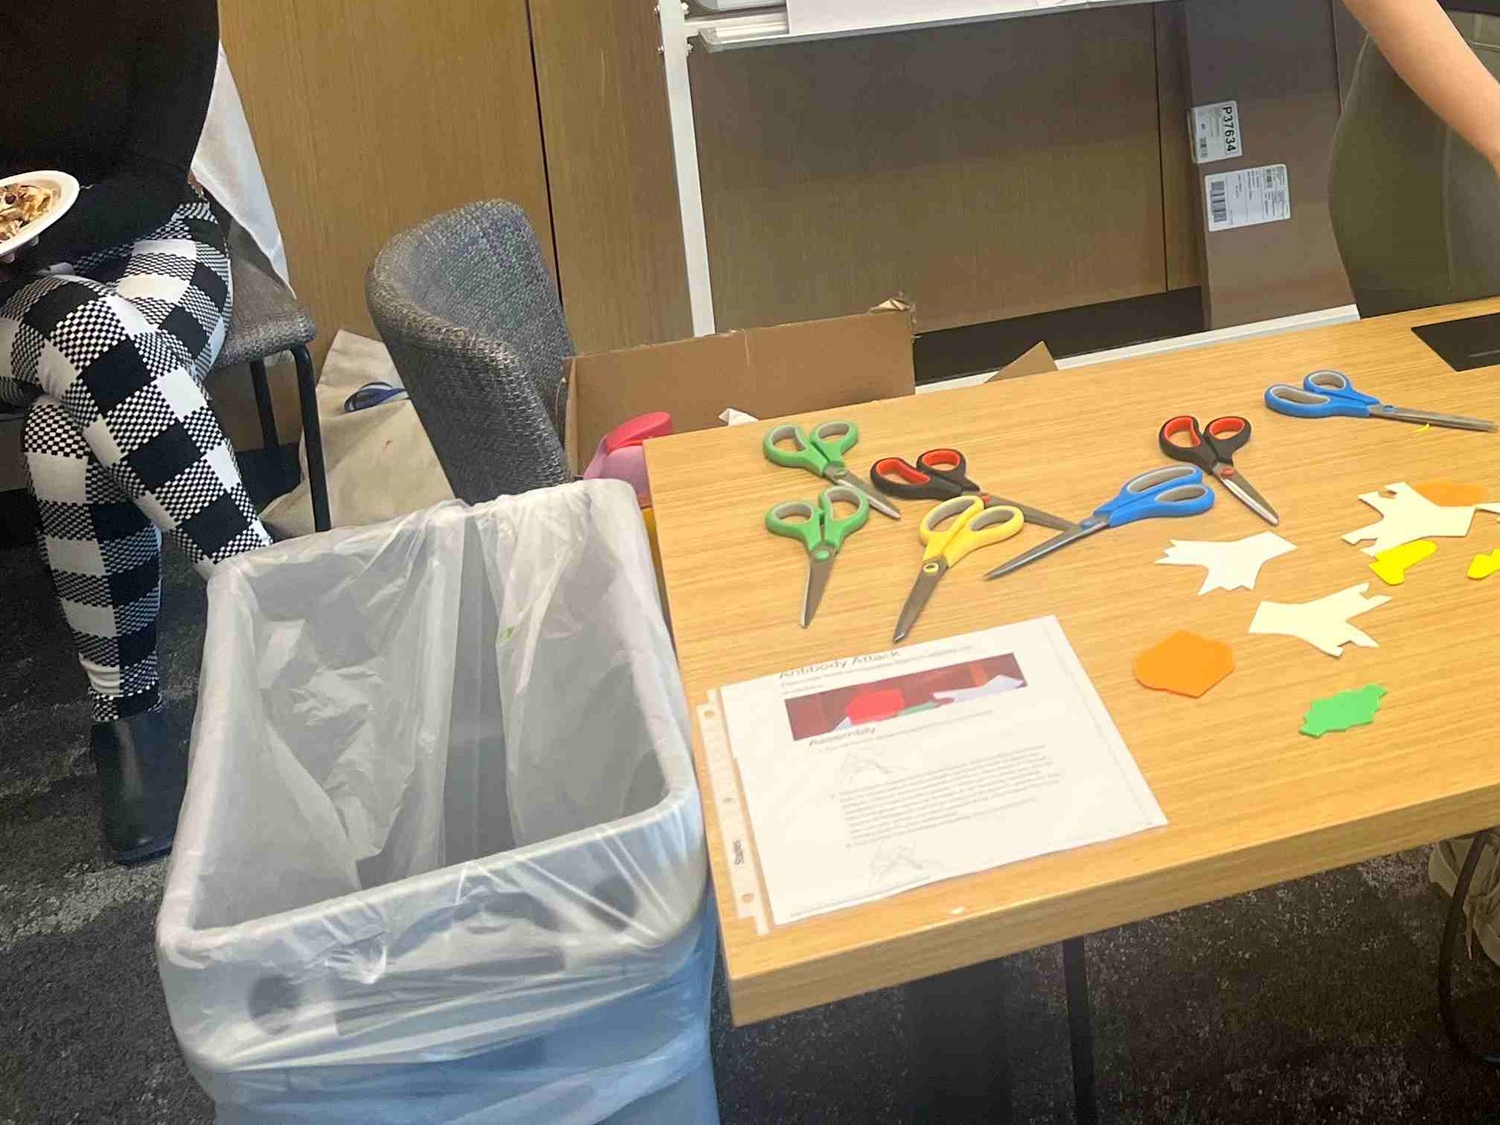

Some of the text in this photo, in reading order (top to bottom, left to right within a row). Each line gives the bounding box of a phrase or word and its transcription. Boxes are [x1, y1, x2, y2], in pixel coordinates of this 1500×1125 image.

[1221, 106, 1237, 152] P37634
[779, 650, 899, 679] Antibody Attack
